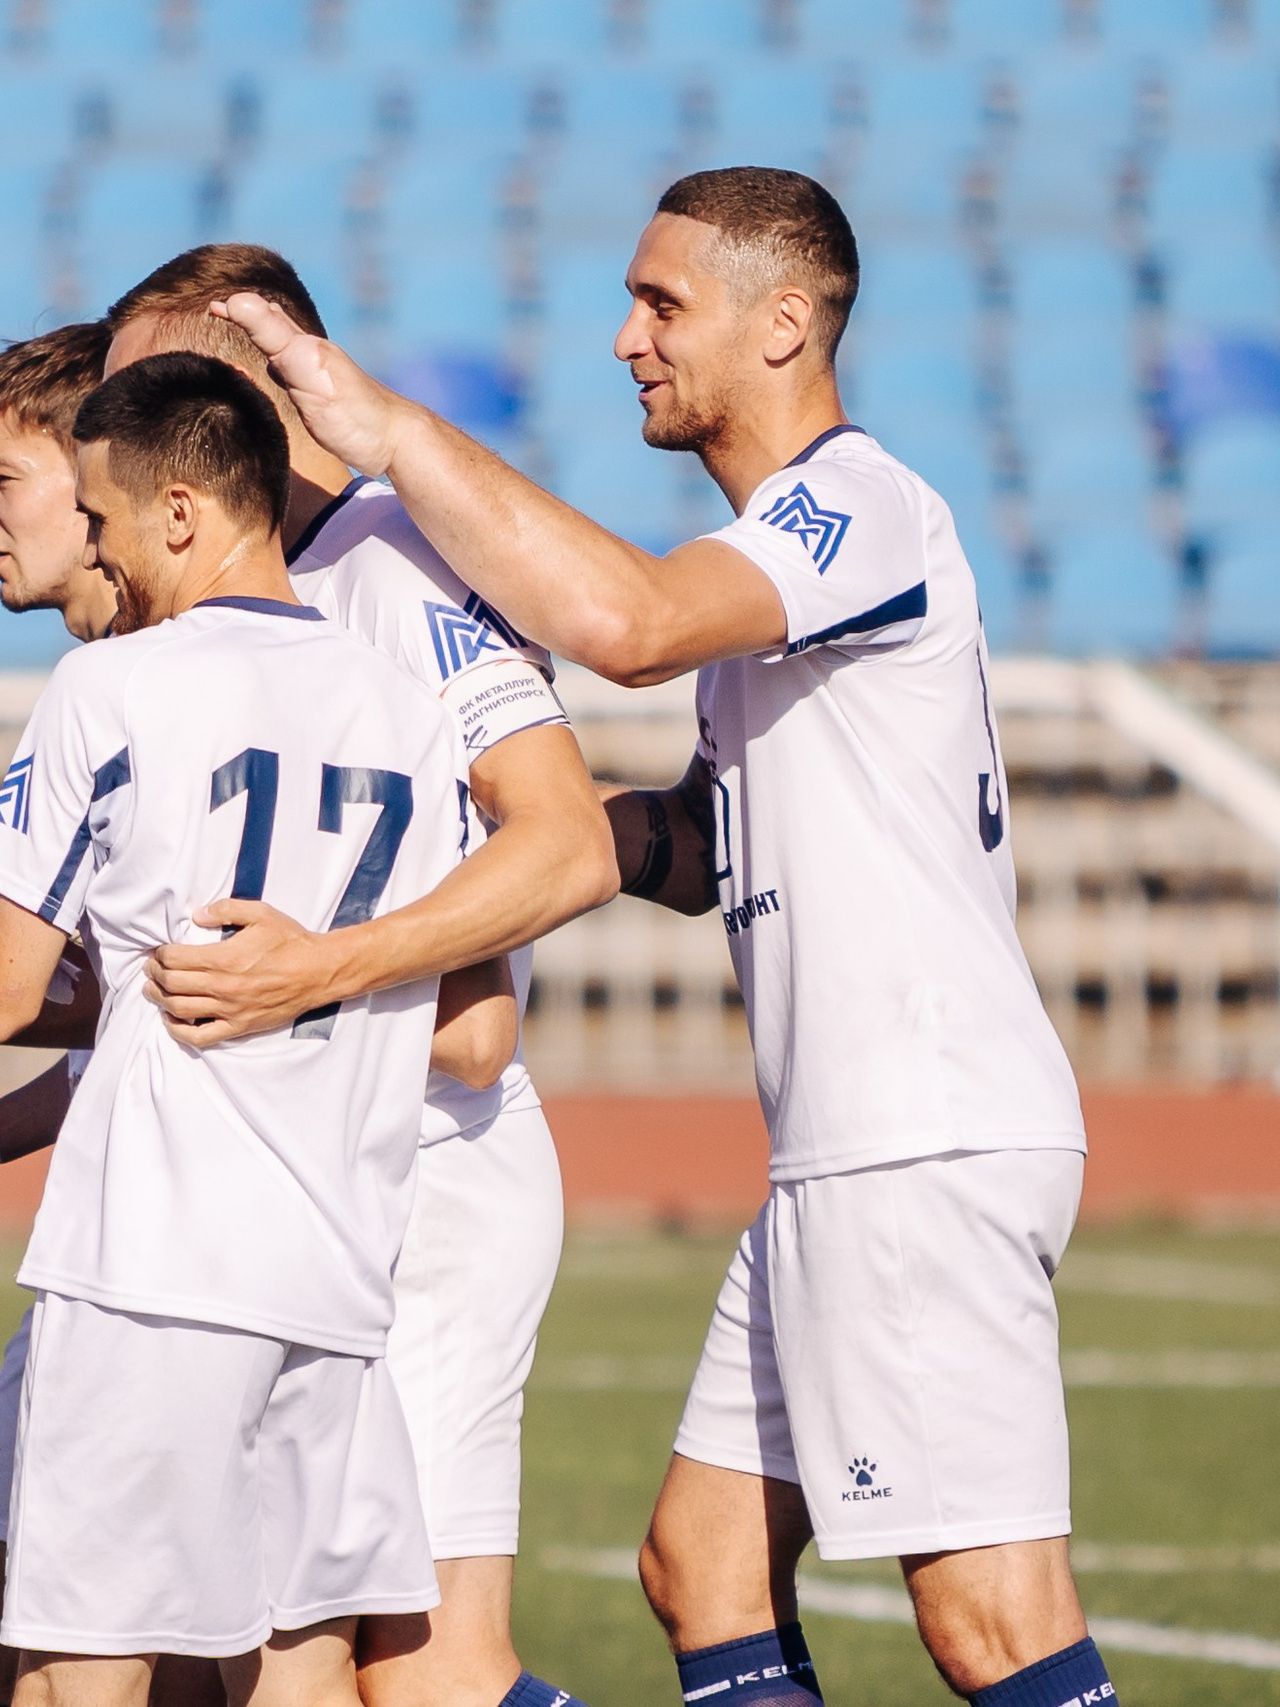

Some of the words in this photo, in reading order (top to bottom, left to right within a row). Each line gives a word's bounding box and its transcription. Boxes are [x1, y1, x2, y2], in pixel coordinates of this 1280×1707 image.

[458, 701, 474, 715] ФК
[474, 678, 535, 704] МЕТАЛЛУРГ
[463, 689, 546, 728] МАГНИТОГОРСК
[209, 747, 414, 1041] 17
[841, 1487, 893, 1502] KELME
